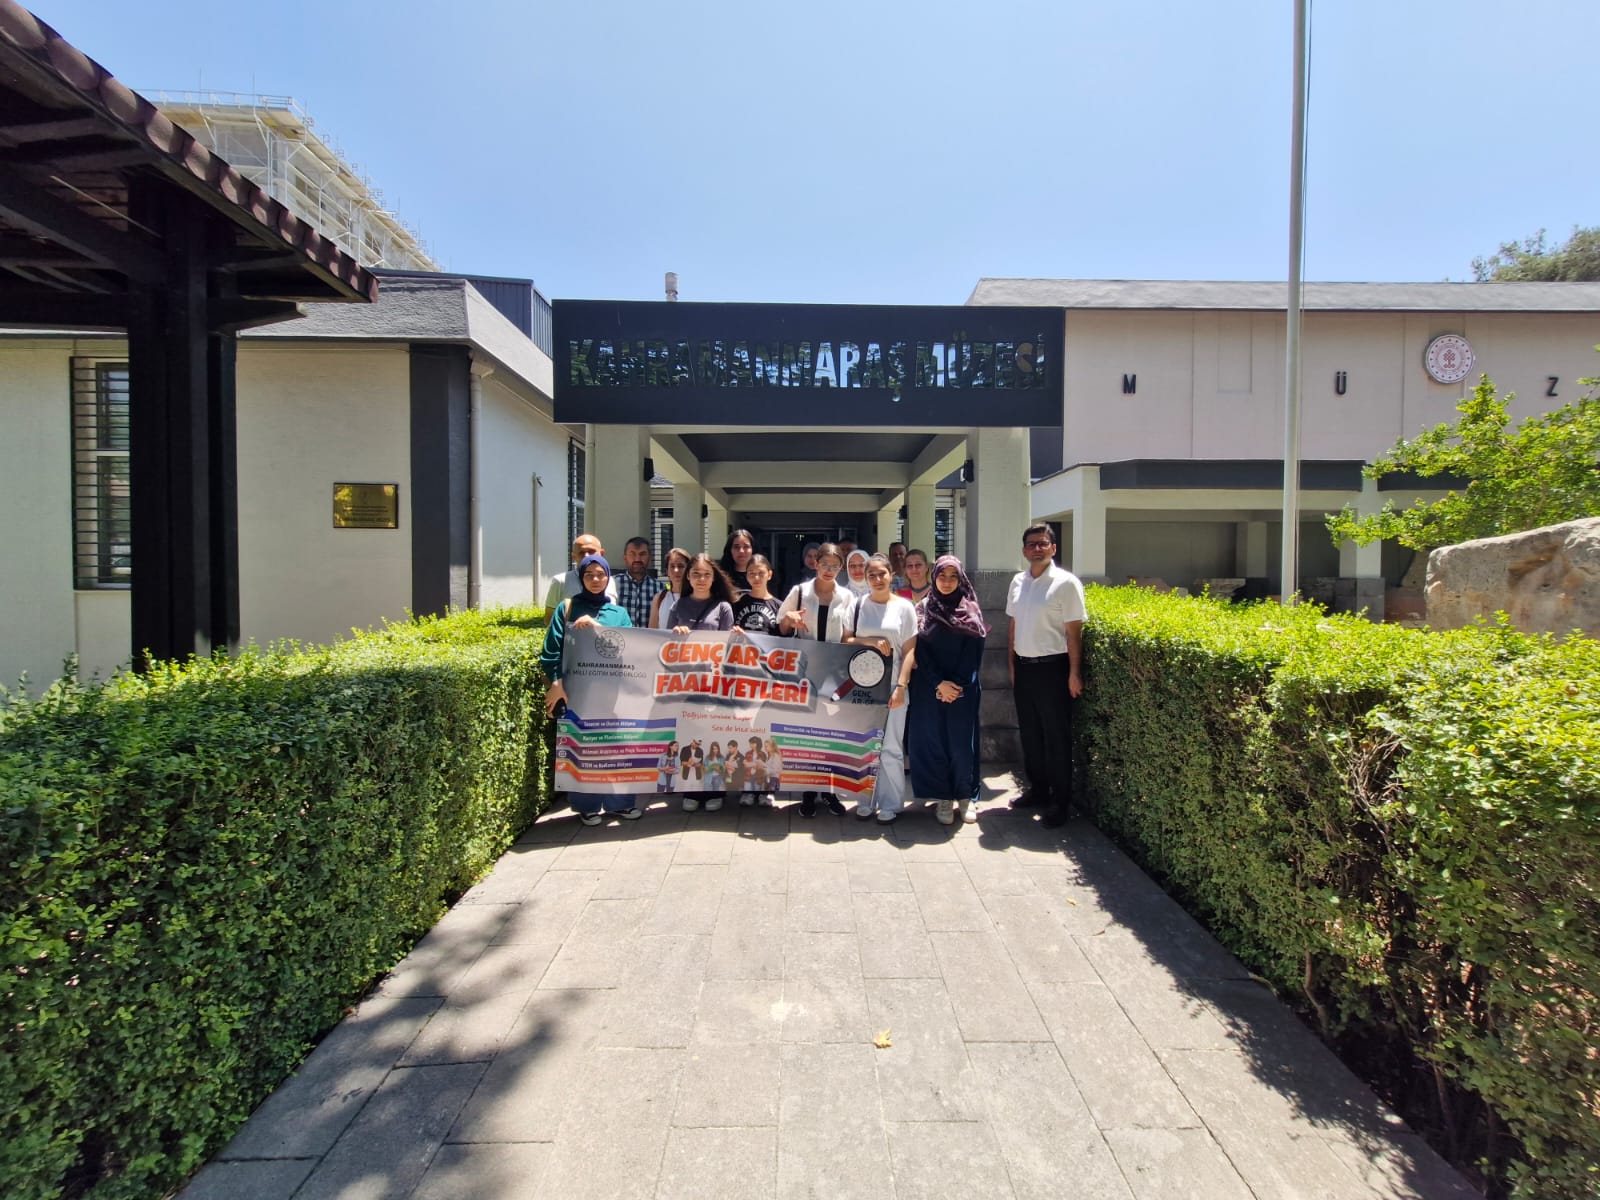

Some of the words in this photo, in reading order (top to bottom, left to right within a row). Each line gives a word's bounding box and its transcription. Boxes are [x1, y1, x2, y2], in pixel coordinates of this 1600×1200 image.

[1122, 373, 1137, 394] M
[1335, 370, 1347, 396] Ü
[1546, 376, 1559, 397] Z
[660, 642, 724, 669] GENÇ
[727, 644, 799, 672] AR-GE
[655, 670, 809, 704] FAALİYETLERİ
